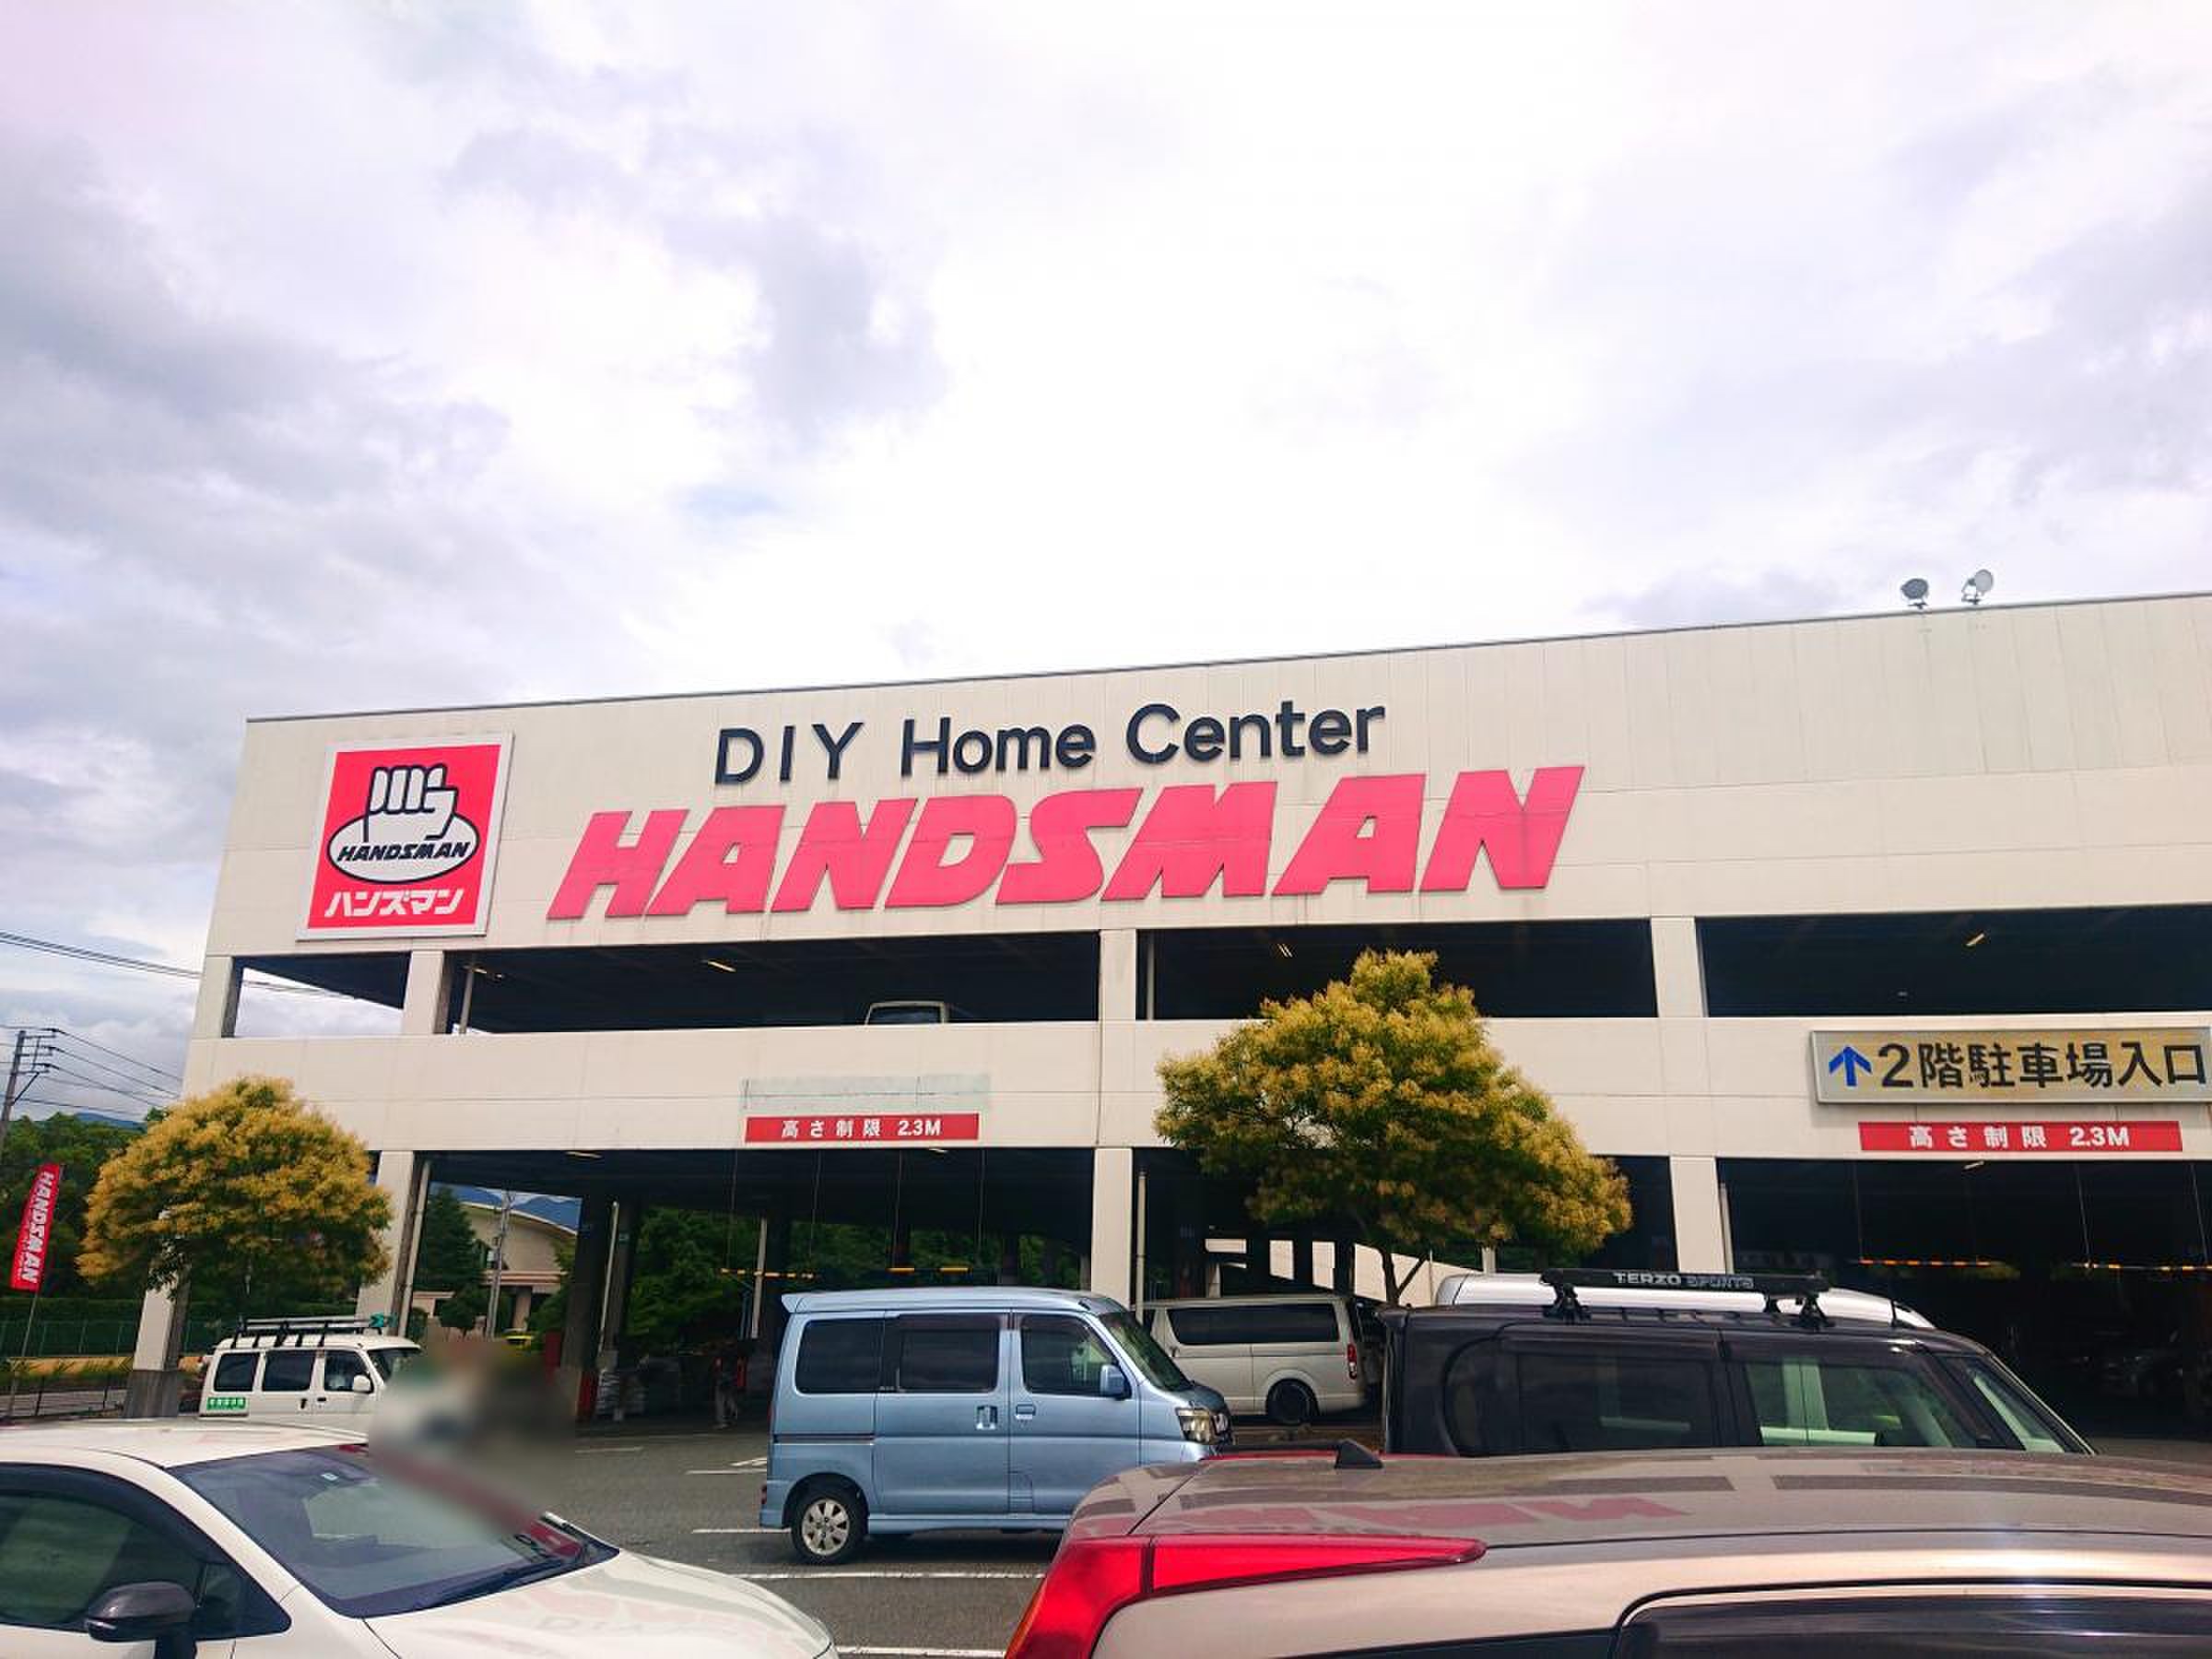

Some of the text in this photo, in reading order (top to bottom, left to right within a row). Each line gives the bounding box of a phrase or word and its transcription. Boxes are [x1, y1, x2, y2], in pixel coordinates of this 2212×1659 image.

[715, 700, 1385, 783] DIY Home Center
[337, 841, 470, 862] HANDSMAN
[547, 767, 1584, 920] HANDSMAN
[324, 888, 464, 917] ハンズマン
[1877, 1041, 2206, 1088] 2階駐車場入口
[898, 1120, 942, 1136] 2.3M
[1910, 1125, 2129, 1148] 高さ制限 2.3M
[20, 1171, 55, 1284] HANDSMAN
[1614, 1271, 1681, 1286] TERZO
